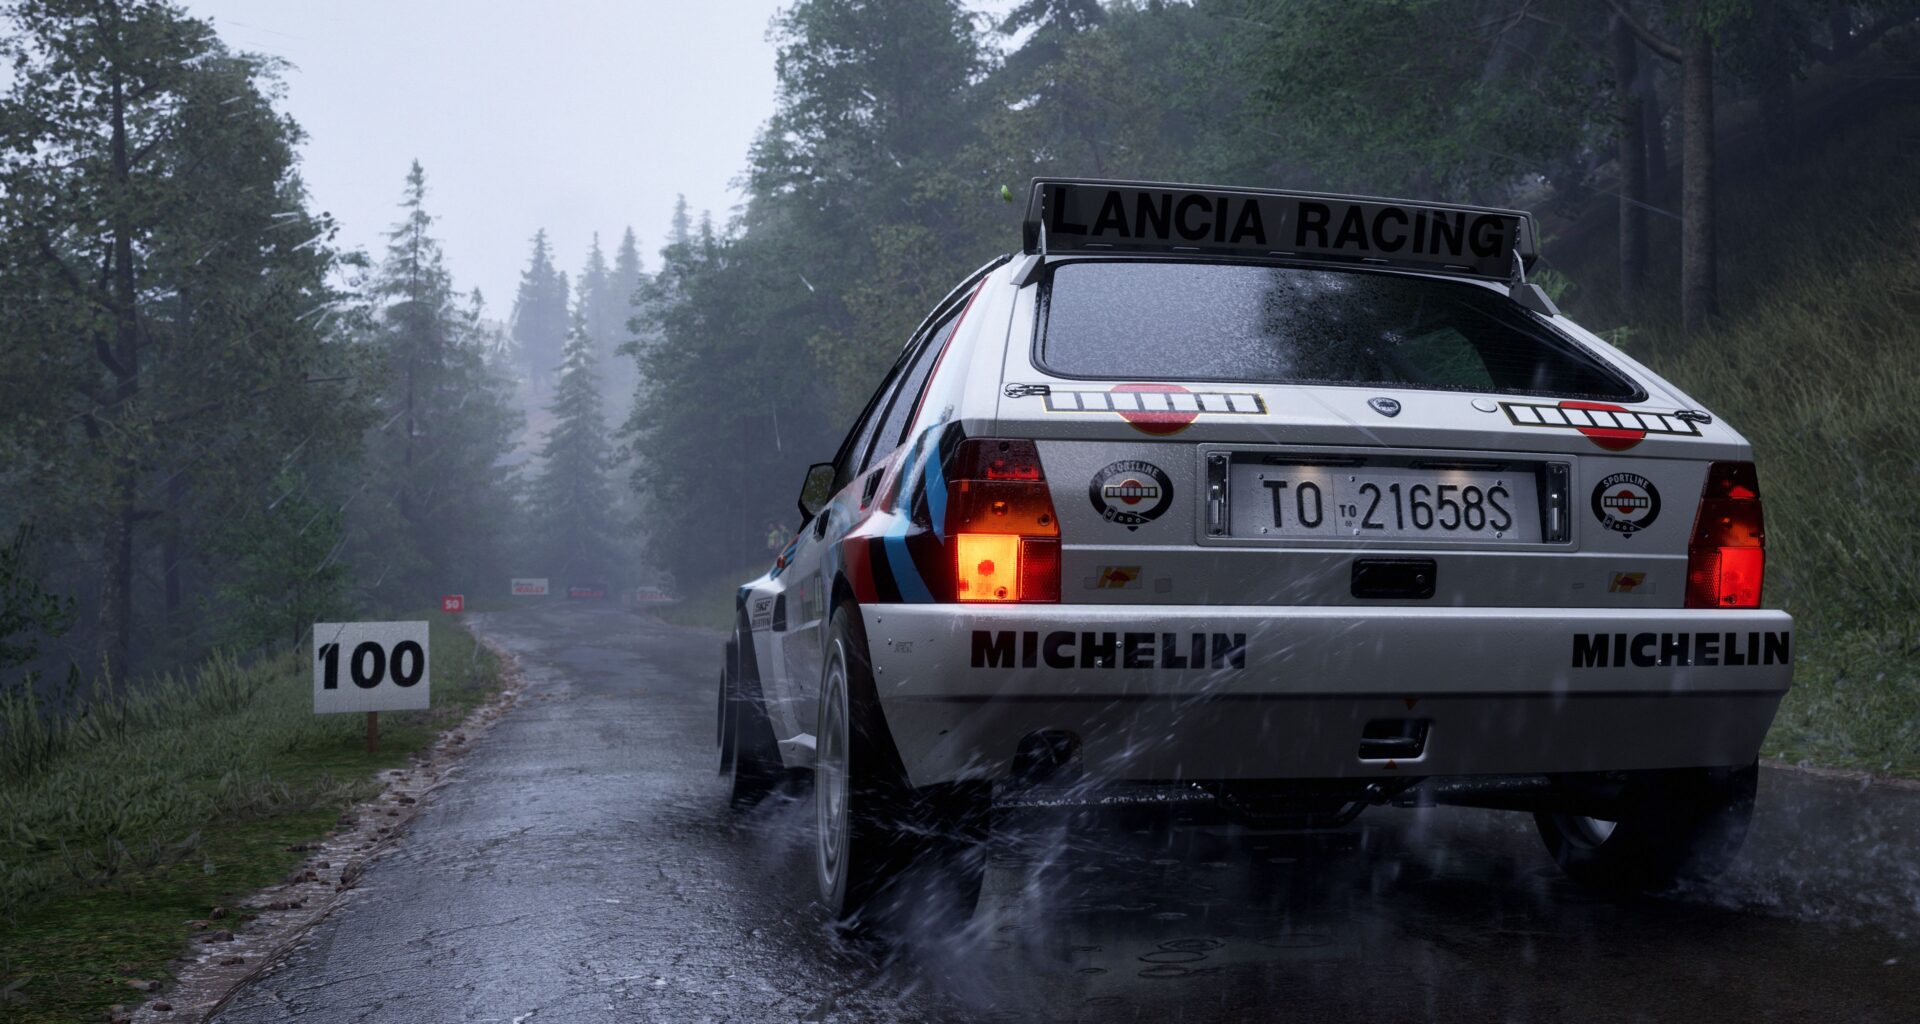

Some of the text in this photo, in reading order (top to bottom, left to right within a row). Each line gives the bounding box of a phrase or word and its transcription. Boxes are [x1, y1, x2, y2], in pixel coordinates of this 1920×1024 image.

[1051, 187, 1505, 259] LANCIA RACING
[1103, 461, 1160, 477] SPORTLINE
[1603, 474, 1650, 489] SPORTLINE
[1262, 480, 1512, 532] TO 21658S
[1339, 504, 1357, 518] TO
[445, 599, 460, 609] 50
[318, 639, 425, 690] 100
[970, 630, 1247, 670] MICHELIN
[1571, 631, 1790, 669] MICHELIN
